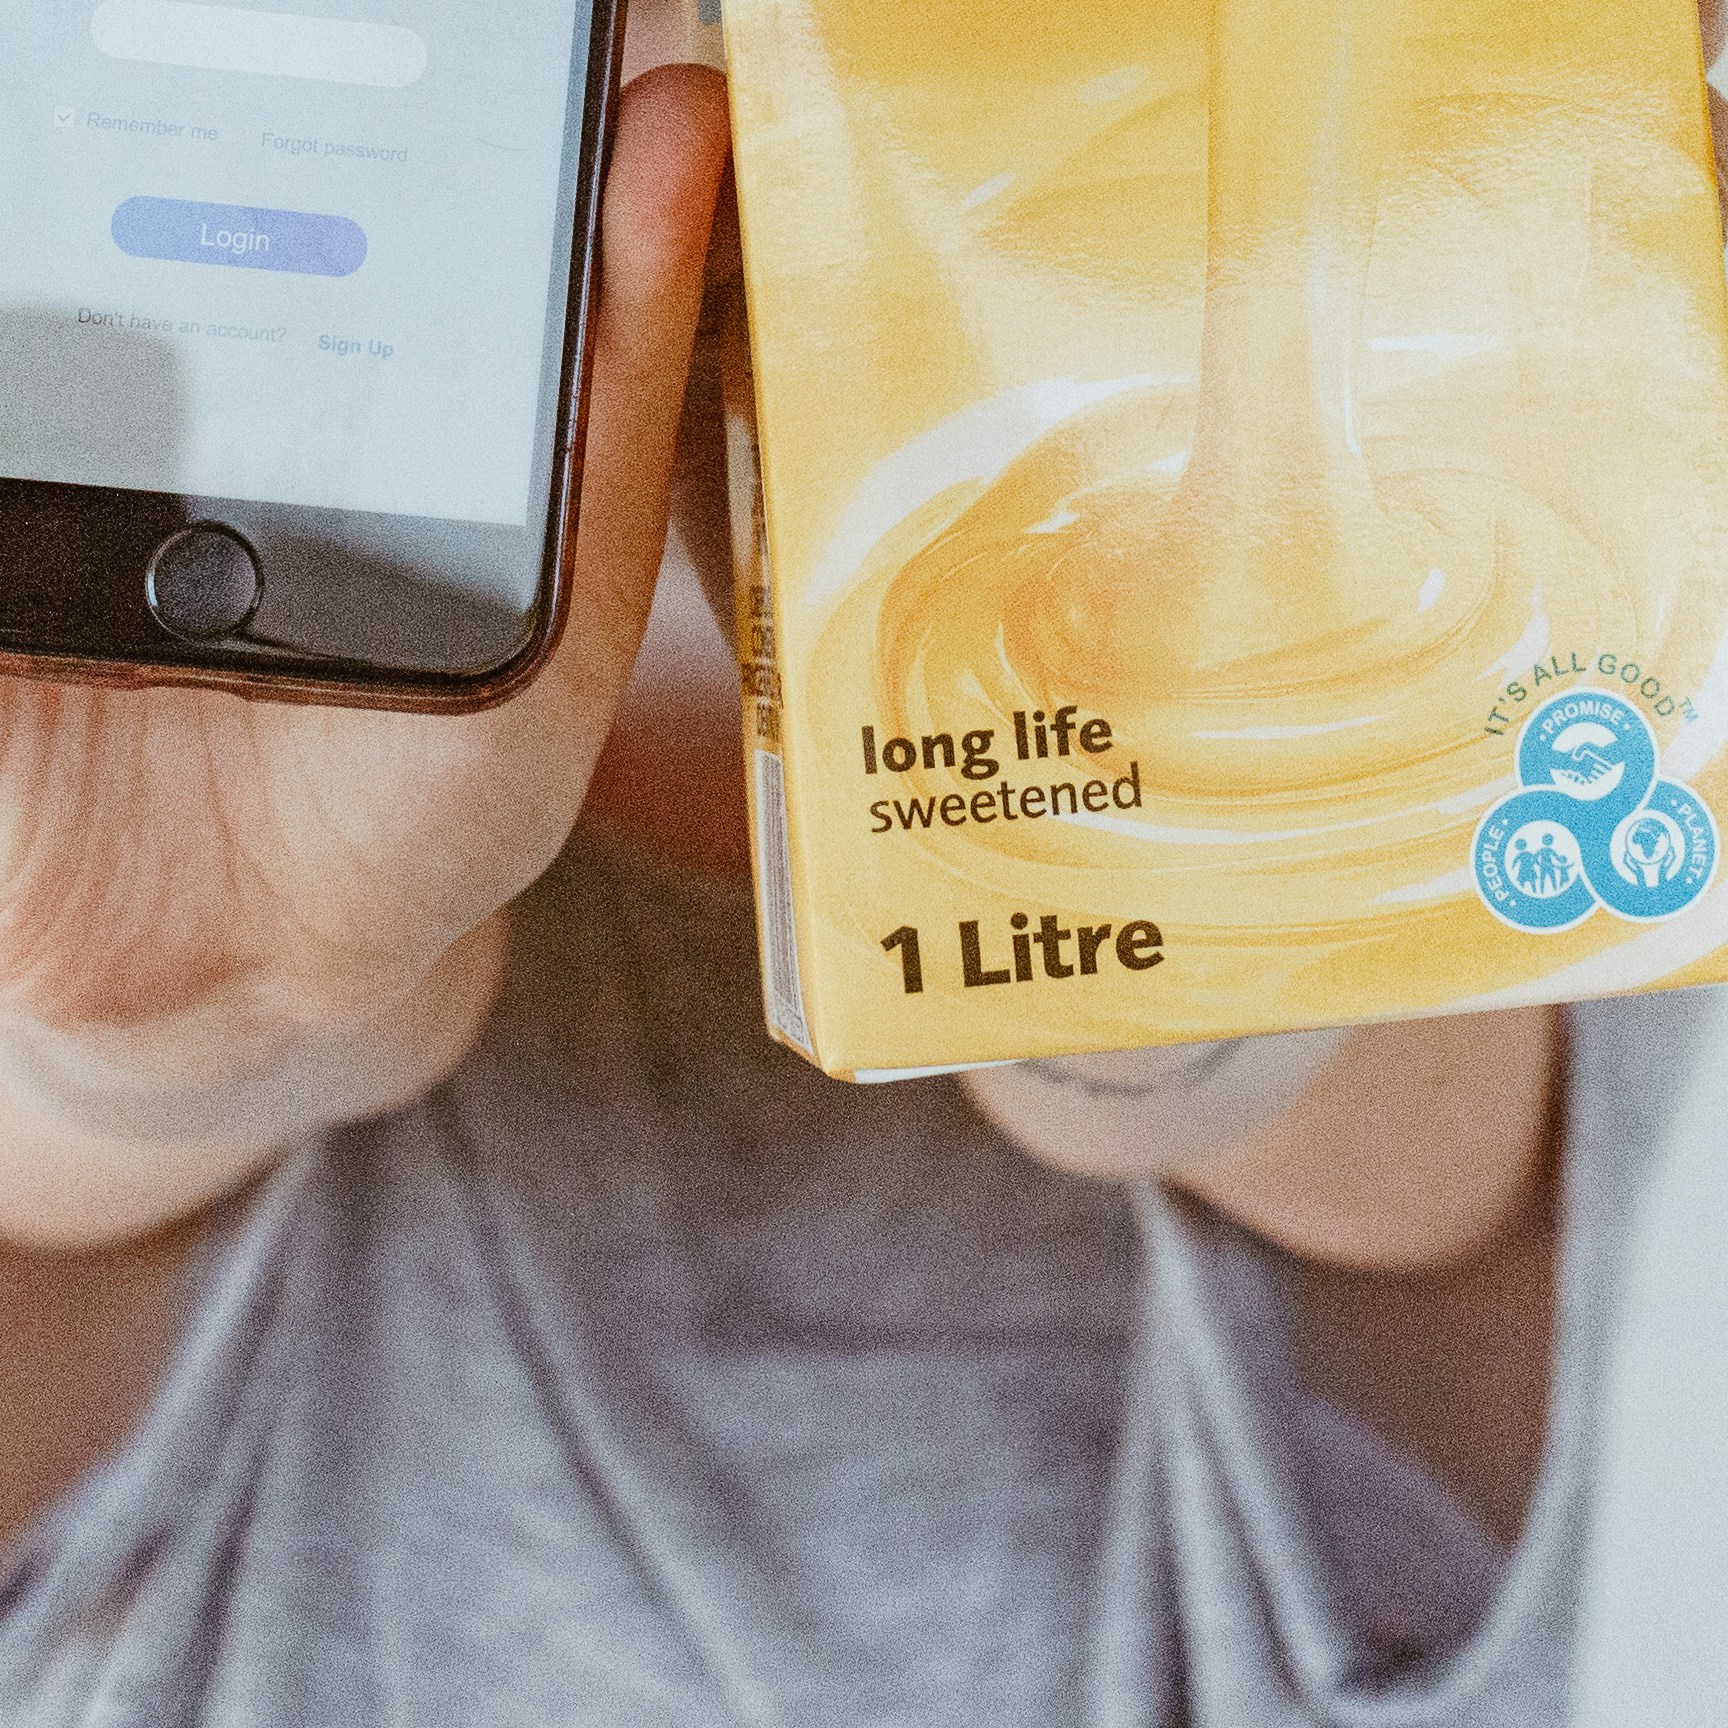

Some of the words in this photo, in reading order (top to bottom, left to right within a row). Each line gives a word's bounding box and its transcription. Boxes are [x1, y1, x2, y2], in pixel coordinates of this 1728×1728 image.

[86, 111, 185, 139] Remember
[191, 125, 219, 141] me
[261, 131, 318, 155] Forgot
[324, 140, 408, 164] password
[200, 224, 270, 255] Login
[78, 307, 126, 328] Don't
[130, 311, 173, 332] have
[177, 320, 202, 335] an
[206, 321, 287, 343] account?
[317, 334, 361, 356] Sign
[368, 339, 394, 359] Up
[1484, 681, 1528, 736] IT'S
[1532, 652, 1587, 686] ALL
[1542, 700, 1625, 735] PROMISE
[862, 725, 999, 780] long
[1013, 705, 1113, 760] life
[869, 761, 1142, 833] sweetened
[1481, 825, 1510, 903] PEOPLE
[1677, 802, 1709, 880] PLANET
[880, 925, 924, 993] 1
[959, 912, 1165, 987] Litre
